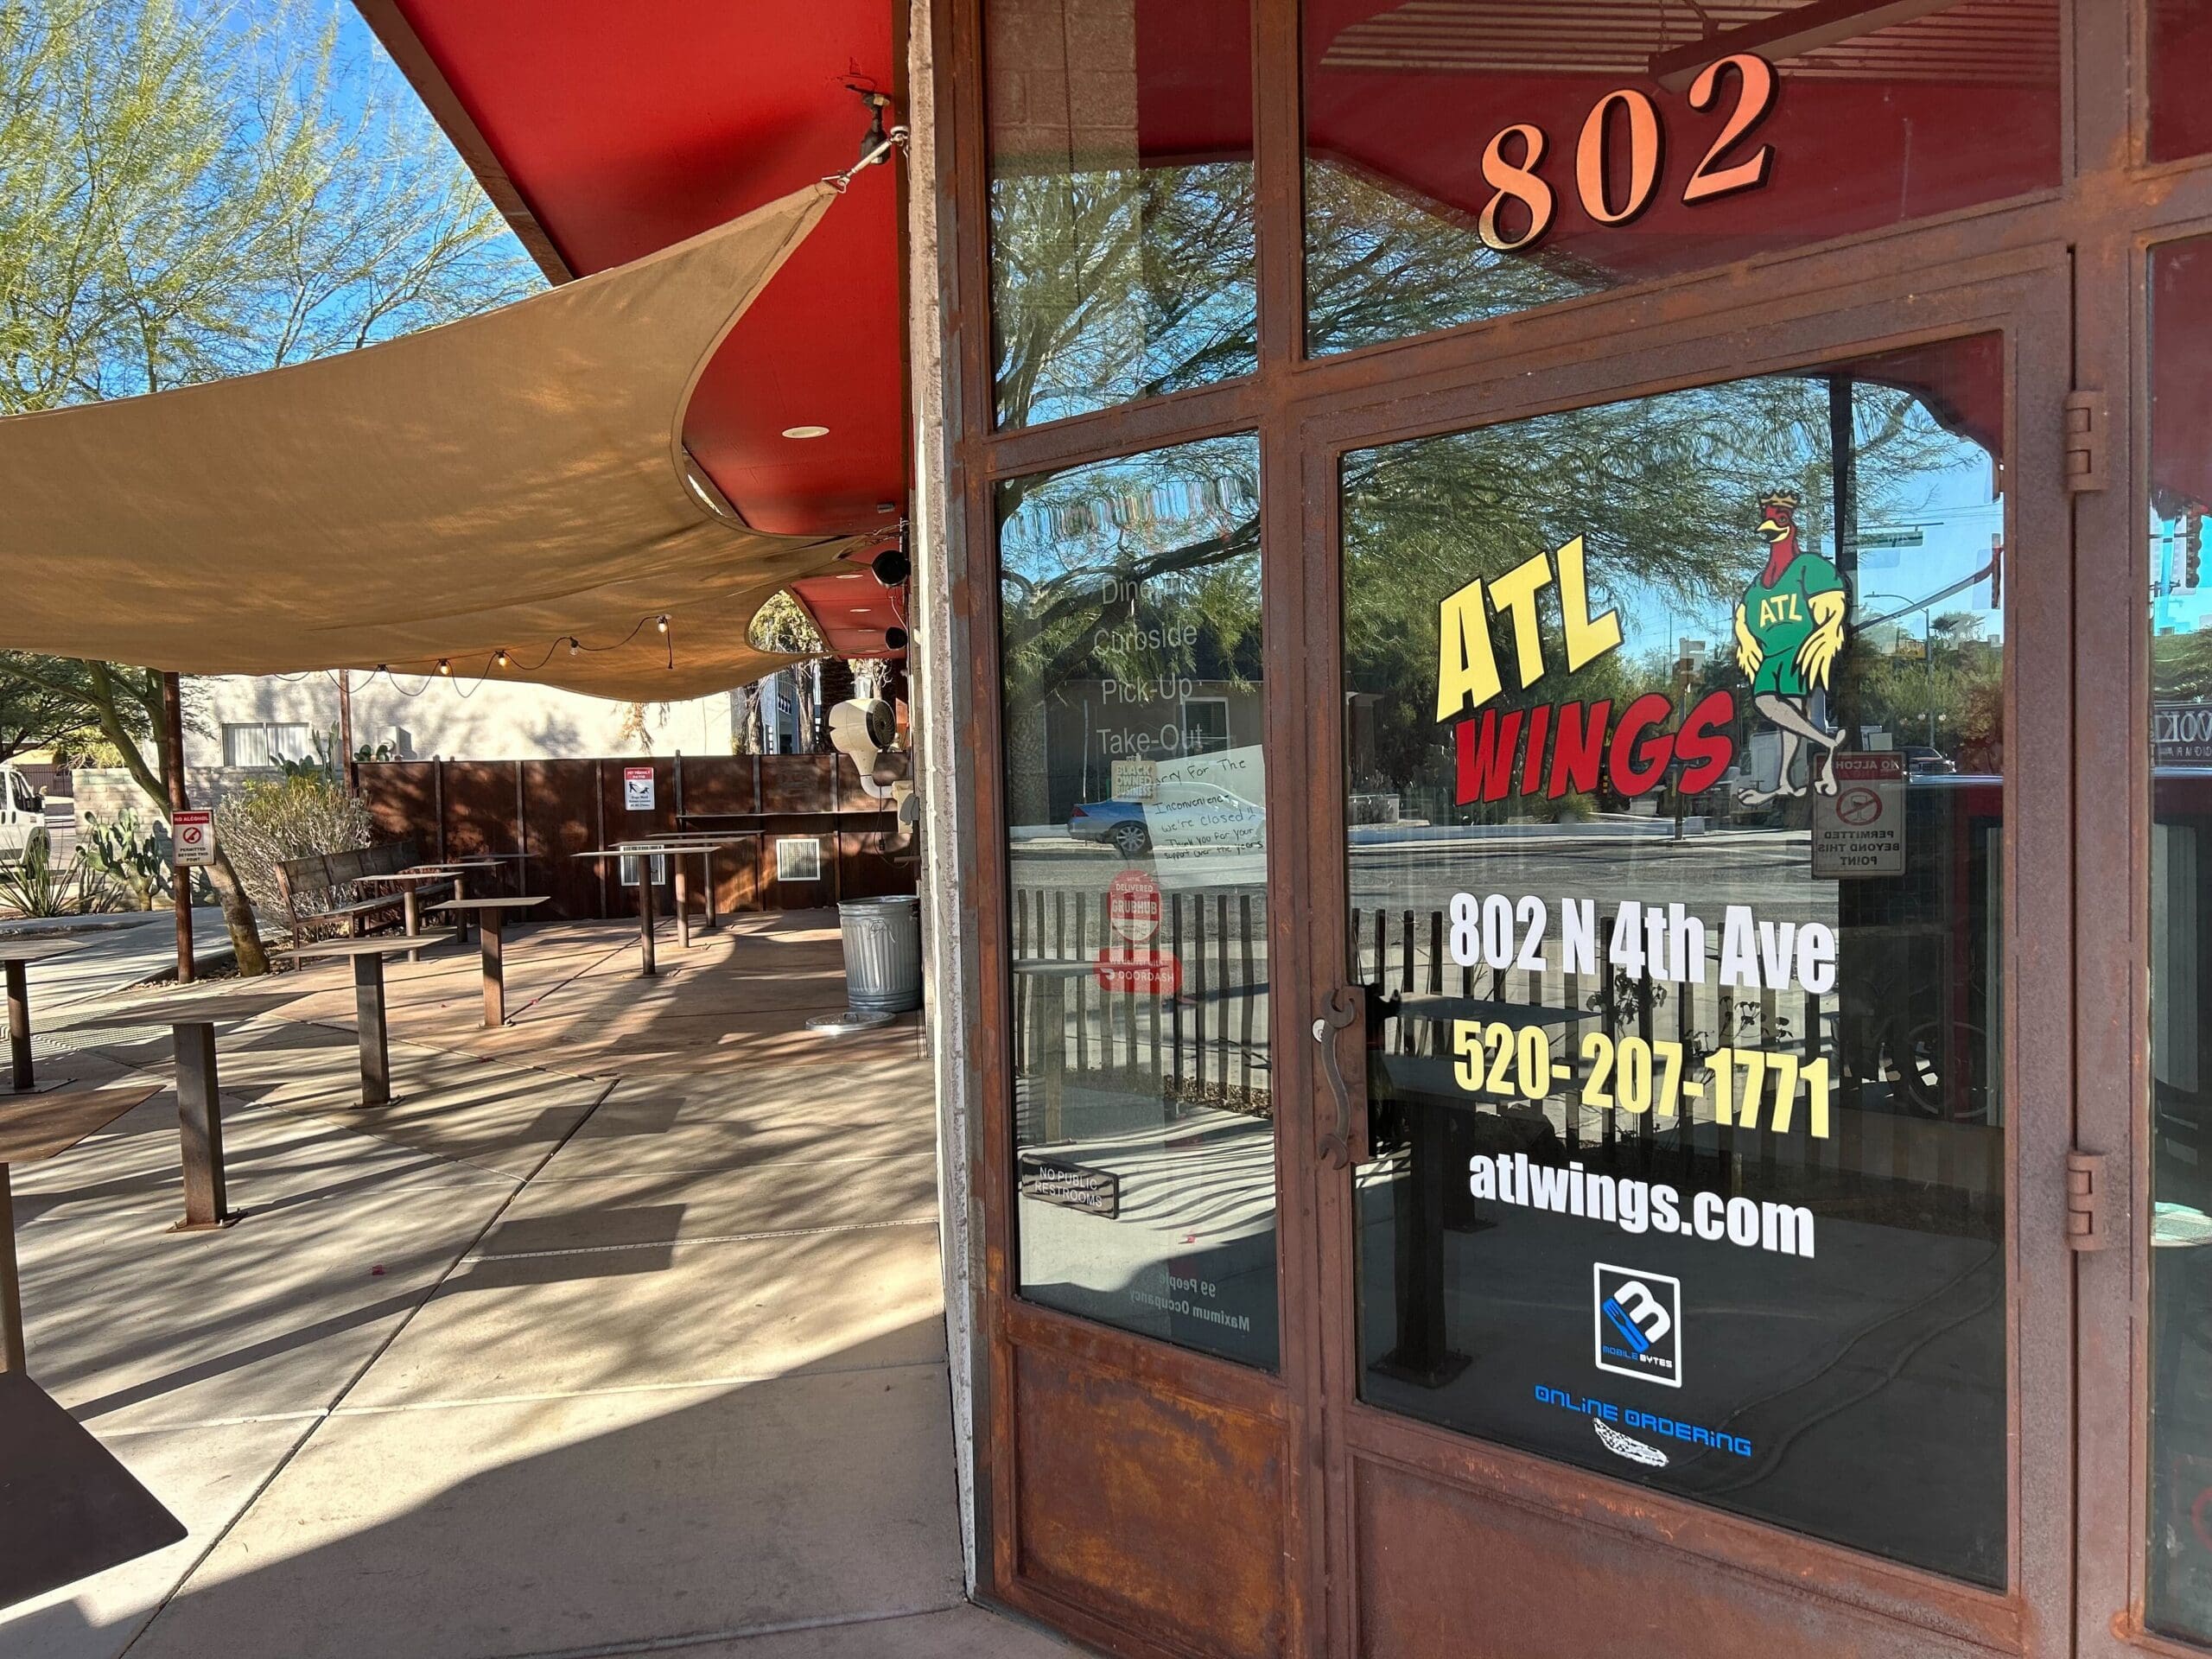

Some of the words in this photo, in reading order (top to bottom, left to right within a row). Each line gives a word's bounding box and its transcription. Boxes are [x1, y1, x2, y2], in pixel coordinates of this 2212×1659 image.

[1478, 54, 1780, 254] 802
[1760, 594, 1802, 628] ATL
[1093, 619, 1198, 655] Curbside
[1435, 534, 1625, 724] ATL
[1102, 672, 1192, 705] Pick-Up
[1096, 722, 1203, 755] Take-Out
[1454, 690, 1734, 807] WINGS
[1116, 765, 1151, 776] BLACK
[1217, 759, 1246, 771] The
[1116, 775, 1152, 786] OWNED
[1116, 785, 1152, 797] BUSINESS
[1116, 883, 1154, 893] DELIVERED
[1112, 899, 1158, 915] GRUBHUB
[1449, 892, 1548, 972] 802
[1560, 897, 1595, 976] N
[1609, 900, 1706, 984] 4th
[1719, 905, 1836, 995] Ave
[1118, 969, 1174, 982] DOORDASH
[1039, 1166, 1055, 1180] NO
[1058, 1171, 1097, 1191] PUBLIC
[1035, 1180, 1103, 1208] RESTROOMS
[1469, 1153, 1815, 1259] atlwings.com
[1602, 1344, 1638, 1361] MOBILE
[1639, 1353, 1673, 1369] BYTES
